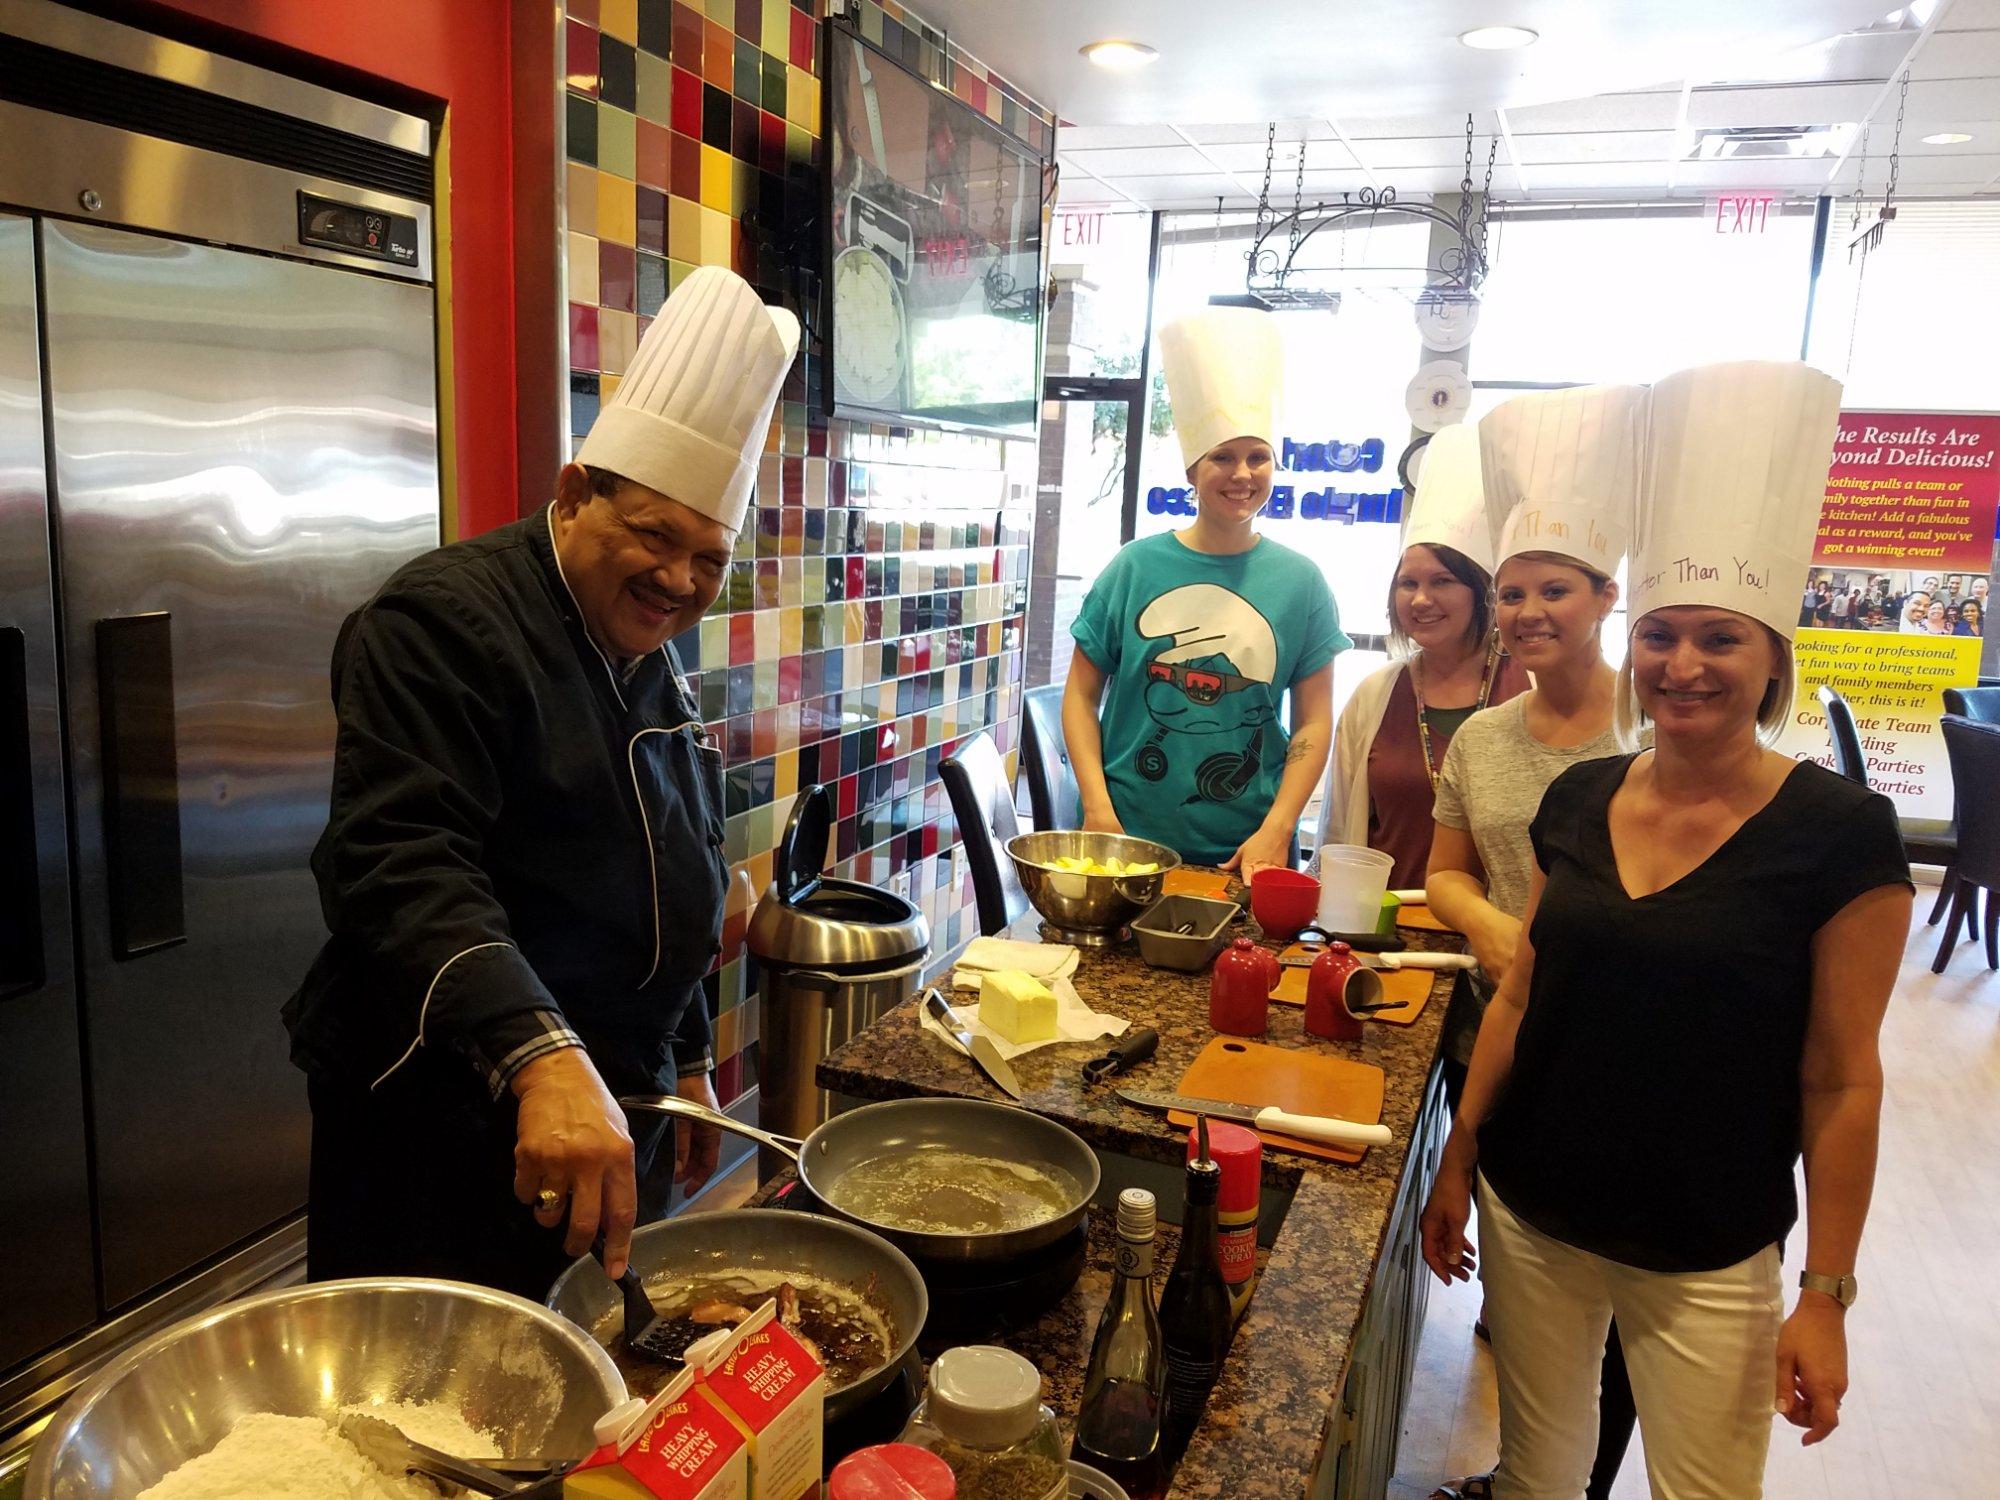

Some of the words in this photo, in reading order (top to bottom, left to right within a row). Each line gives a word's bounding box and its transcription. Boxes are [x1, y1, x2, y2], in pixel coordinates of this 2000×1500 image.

[1717, 198, 1774, 233] EXIT
[1064, 213, 1104, 245] EXIT
[1834, 425, 1857, 443] he
[1861, 426, 1937, 444] Results
[1940, 428, 1980, 446] Are
[1830, 447, 1882, 467] yond
[1885, 448, 1994, 468] Delicious!
[1871, 478, 1902, 491] pulls
[1904, 481, 1912, 489] a
[1915, 480, 1945, 491] team
[1948, 482, 1964, 491] or
[1823, 493, 1848, 506] mily
[1850, 495, 1901, 507] together
[1903, 496, 1931, 507] than
[1932, 496, 1954, 509] fun
[1957, 497, 1970, 508] in
[1829, 510, 1876, 522] kitchen!
[1878, 511, 1905, 522] Add
[1907, 514, 1915, 522] a
[1916, 512, 1970, 525] fabulous
[1832, 528, 1846, 537] as
[1848, 529, 1856, 537] a
[1858, 528, 1905, 540] reward,
[1908, 529, 1932, 540] and
[1933, 530, 1973, 543] you've
[1822, 543, 1843, 555] got
[1845, 545, 1854, 553] a
[1856, 543, 1906, 557] winning
[1907, 546, 1946, 557] event!
[1673, 557, 1719, 583] Than
[1733, 556, 1770, 595] You!
[1841, 642, 1861, 655] for
[1864, 646, 1873, 654] a
[1875, 645, 1958, 661] professional,
[1795, 658, 1805, 667] et
[1808, 657, 1829, 670] fun
[1834, 661, 1860, 672] way
[1863, 661, 1876, 671] to
[1879, 661, 1914, 676] bring
[1917, 665, 1956, 677] teams
[1804, 675, 1829, 686] and
[1830, 675, 1873, 690] family
[1875, 679, 1934, 692] members
[1869, 693, 1893, 706] this
[1896, 696, 1906, 706] is
[1910, 697, 1926, 708] it!
[1796, 711, 1881, 730] Corate
[1885, 717, 1932, 734] Team
[1147, 756, 1159, 771] S
[1866, 757, 1926, 775] Parties
[742, 1351, 776, 1384] HEAVY
[749, 1357, 789, 1394] WHIPPING
[761, 1367, 797, 1401] CREAM
[660, 1422, 696, 1460] HEAVY
[666, 1427, 709, 1470] WHIPPING
[680, 1438, 718, 1478] CREAM
